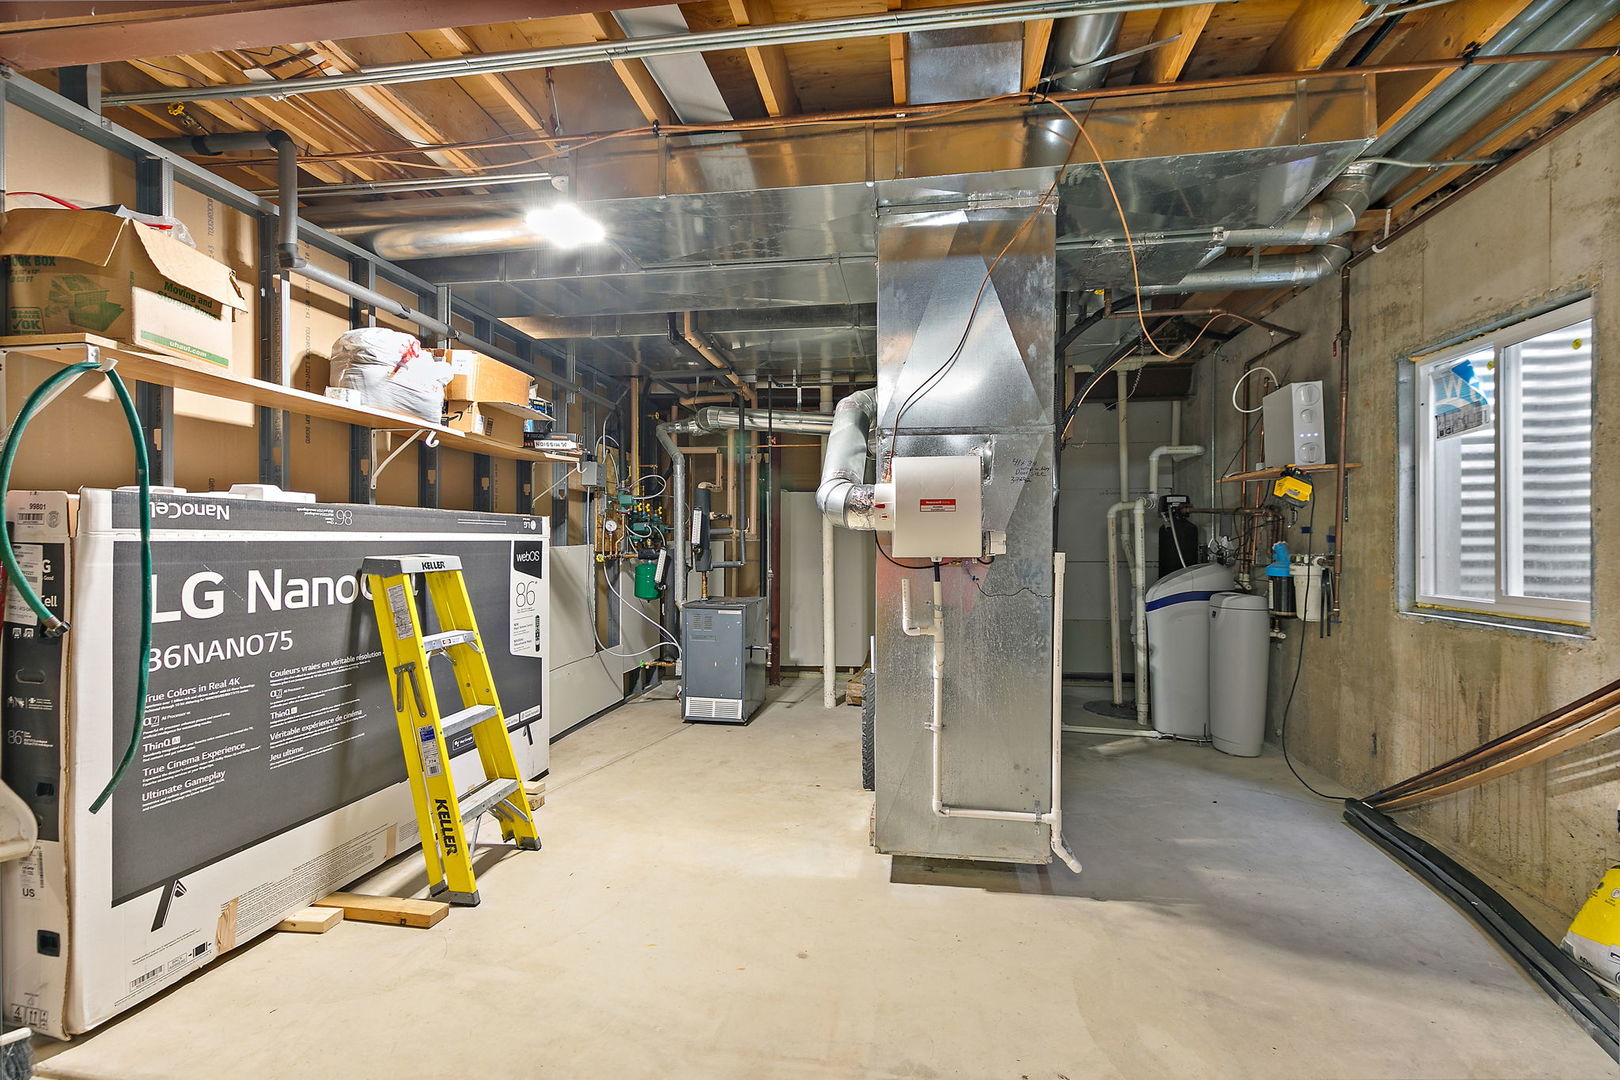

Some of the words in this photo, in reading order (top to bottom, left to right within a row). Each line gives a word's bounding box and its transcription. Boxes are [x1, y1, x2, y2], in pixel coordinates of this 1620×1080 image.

[163, 281, 197, 304] Moving
[198, 297, 213, 309] and
[169, 340, 207, 358] uhaul.com
[149, 500, 231, 522] NanoCel
[420, 561, 446, 571] KELLER
[516, 550, 541, 562] webOS
[151, 571, 225, 625] LG
[269, 666, 301, 679] Couleurs
[301, 662, 321, 672] vraies
[321, 660, 330, 668] en
[330, 656, 356, 667] véritable
[166, 687, 197, 699] Colors
[198, 684, 207, 693] in
[208, 679, 227, 691] Real
[228, 676, 241, 687] 4K
[269, 726, 302, 741] Véritable
[301, 717, 336, 733] expérience
[335, 713, 343, 722] de
[343, 709, 363, 720] cinéma
[143, 738, 172, 753] ThinQ
[269, 751, 282, 762] Jeu
[282, 746, 304, 758] ultime
[143, 764, 166, 777] True
[166, 755, 201, 771] Cinema
[201, 742, 247, 761] Experience
[142, 784, 183, 802] Ultimate
[184, 769, 227, 789] Gameplay
[433, 798, 458, 857] KELLER
[22, 887, 36, 898] US
